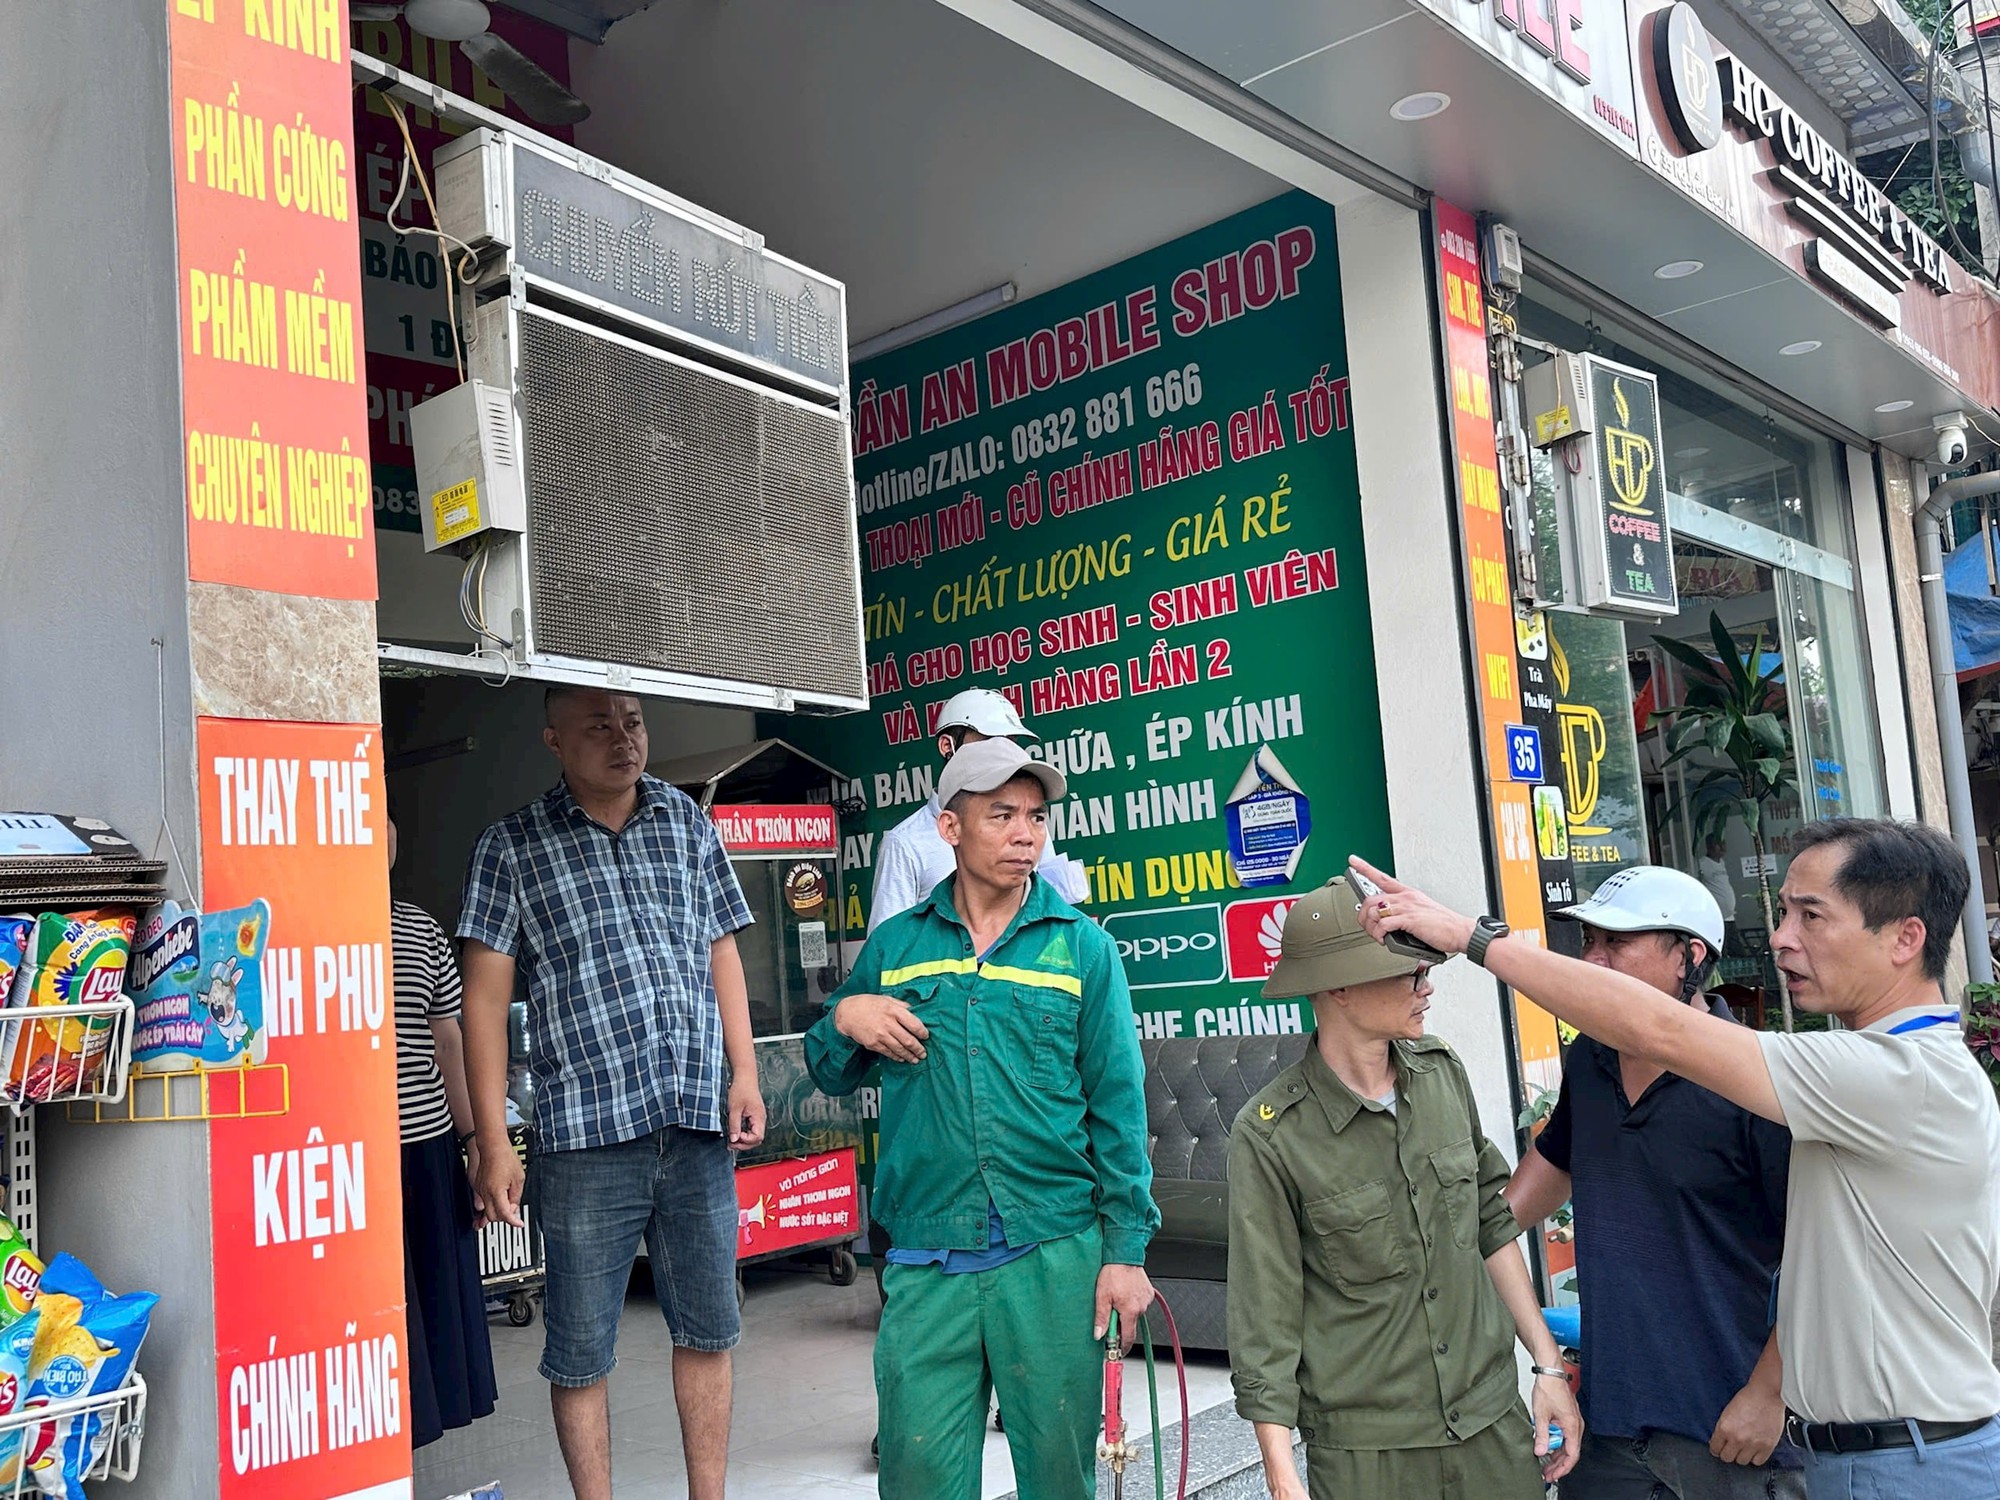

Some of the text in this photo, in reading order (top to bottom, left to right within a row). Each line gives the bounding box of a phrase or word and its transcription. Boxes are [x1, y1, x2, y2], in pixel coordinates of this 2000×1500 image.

[184, 80, 349, 223] PHẦN CỨNG
[1779, 104, 1884, 235] COFFEE
[1888, 202, 1907, 252] &
[1906, 222, 1953, 294] TEA
[364, 233, 438, 290] BẢO
[285, 268, 356, 385] MỀM
[851, 225, 1316, 459] ẦN AN MOBILE SHOP
[1011, 406, 1078, 465] 0832
[1085, 384, 1135, 441] 881
[1145, 361, 1203, 420] 666
[189, 421, 368, 558] CHUYÊN NGHIỆP
[865, 513, 933, 573] THOẠI
[936, 491, 986, 553] MỚI
[1006, 474, 1047, 531] CŨ
[1046, 450, 1133, 519] CHÍNH
[1138, 425, 1222, 491] HÃNG
[1228, 388, 1288, 463] GIÁ
[1288, 364, 1350, 443] TỐT
[931, 555, 1007, 625] CHẤT
[1016, 545, 1132, 605] LƯỢNG
[1165, 494, 1229, 563] GIÁ
[1241, 472, 1297, 544] RẺ
[1608, 513, 1661, 543] COFFEE
[1632, 543, 1645, 567] &
[1625, 569, 1656, 594] TEA
[905, 643, 964, 689] CHO
[970, 624, 1031, 680] HỌC
[1039, 602, 1118, 658] SINH
[1148, 575, 1237, 631] SINH
[1245, 546, 1340, 609] VIÊN
[882, 702, 922, 746] VÀ
[1030, 666, 1121, 717] HÀNG
[1129, 636, 1199, 697] LẦN
[1205, 638, 1233, 681] 2
[1486, 652, 1513, 701] WIFI
[1523, 691, 1553, 714] Pha Máy
[1528, 666, 1544, 684] Trà
[873, 756, 934, 805] BÁN
[1145, 711, 1194, 763] ÉP
[1204, 692, 1304, 752] KÍNH
[1513, 735, 1535, 773] 35
[214, 733, 373, 846] THAY THẾ
[1046, 791, 1116, 842] MÀN
[1126, 777, 1217, 832] HÌNH
[755, 813, 793, 843] THƠM
[795, 817, 832, 843] NGON
[1591, 845, 1600, 862] &
[1600, 845, 1621, 863] TEA
[1086, 857, 1144, 904] TÍN
[1546, 877, 1573, 903] Sinh Tố
[130, 922, 195, 993] Alpenliebe
[164, 995, 190, 1019] NGON
[314, 943, 385, 1049] PHỤ
[1194, 998, 1303, 1038] CHÍNH
[164, 1019, 186, 1045] TRÁI
[185, 1019, 204, 1044] CÂY
[252, 1126, 366, 1260] KIỆN
[229, 1321, 401, 1475] CHÍNH HÃNG
